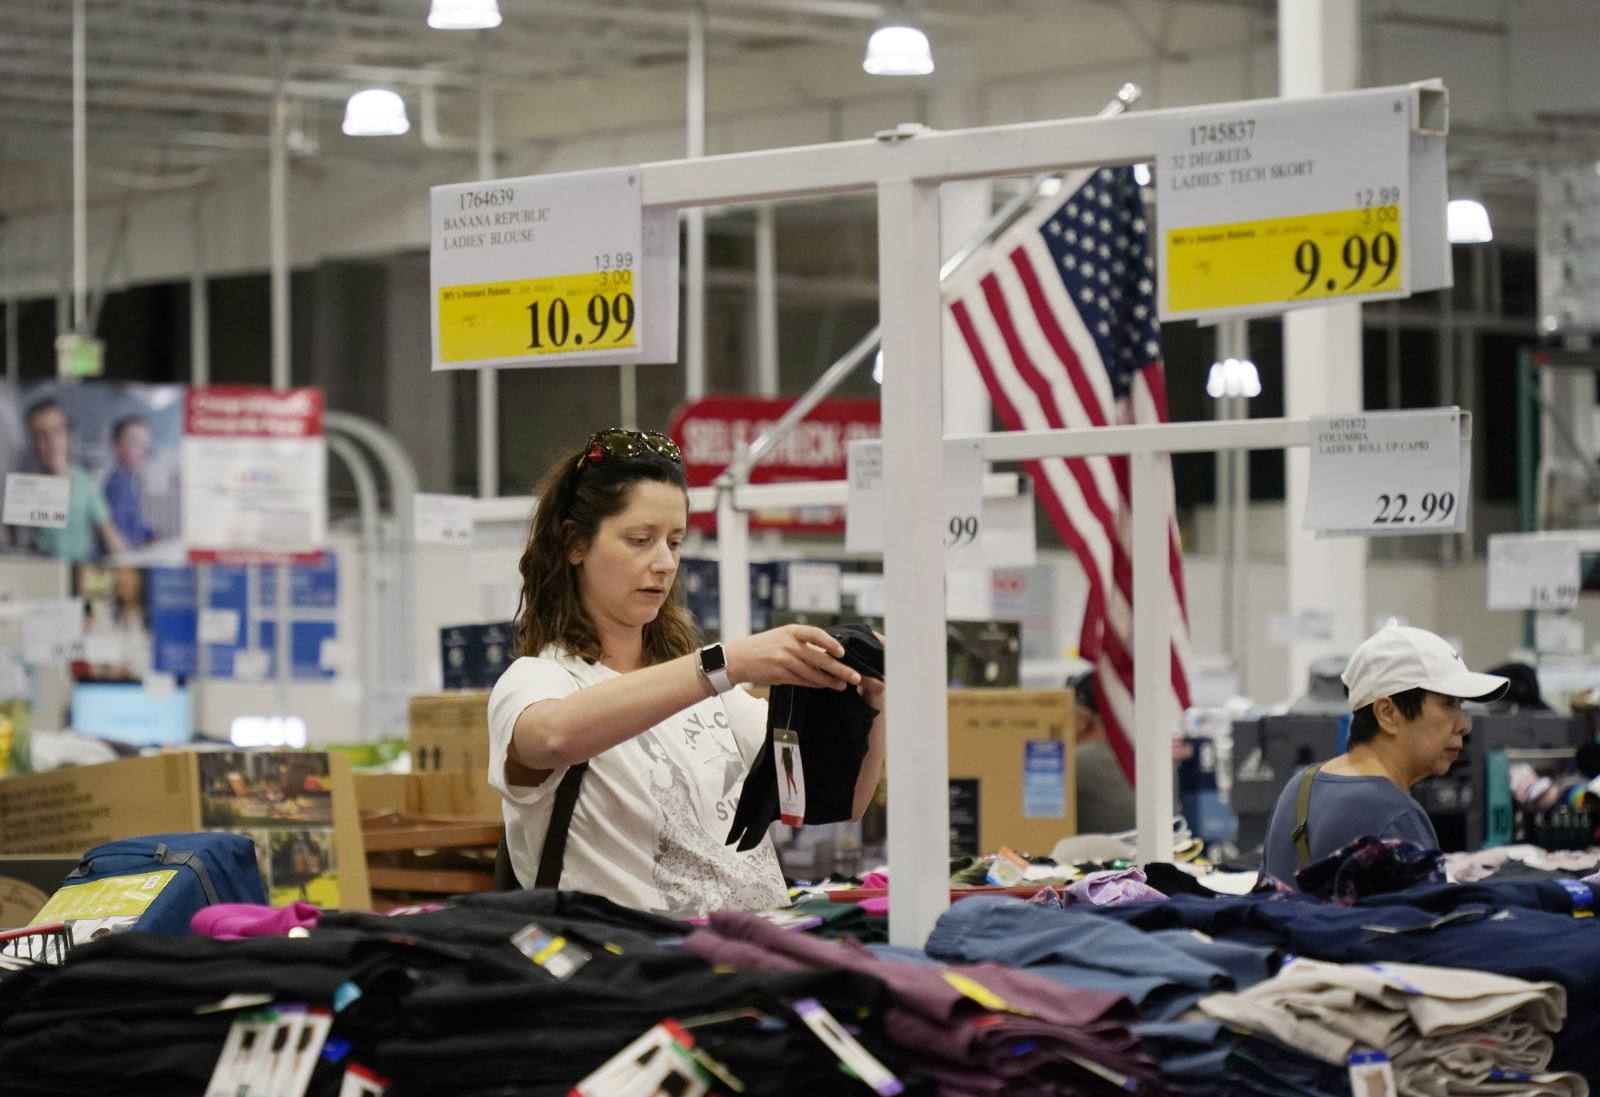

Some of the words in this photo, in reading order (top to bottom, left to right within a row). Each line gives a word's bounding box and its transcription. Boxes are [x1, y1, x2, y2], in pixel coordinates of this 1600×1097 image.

[1189, 119, 1256, 147] 1745837
[1188, 146, 1253, 168] DEGREES
[1230, 166, 1267, 184] TECH
[1270, 160, 1314, 179] SKORT
[459, 187, 515, 210] 1764639
[1354, 186, 1400, 207] 12.99
[443, 214, 492, 231] BANANA
[494, 207, 551, 226] REPUBLIC
[490, 228, 536, 246] BLOUSE
[594, 252, 634, 270] 13.99
[1294, 231, 1399, 297] 9.99
[525, 292, 636, 350] 10.99
[1318, 431, 1369, 443] COLUMBIA
[1373, 490, 1455, 525] 22.99
